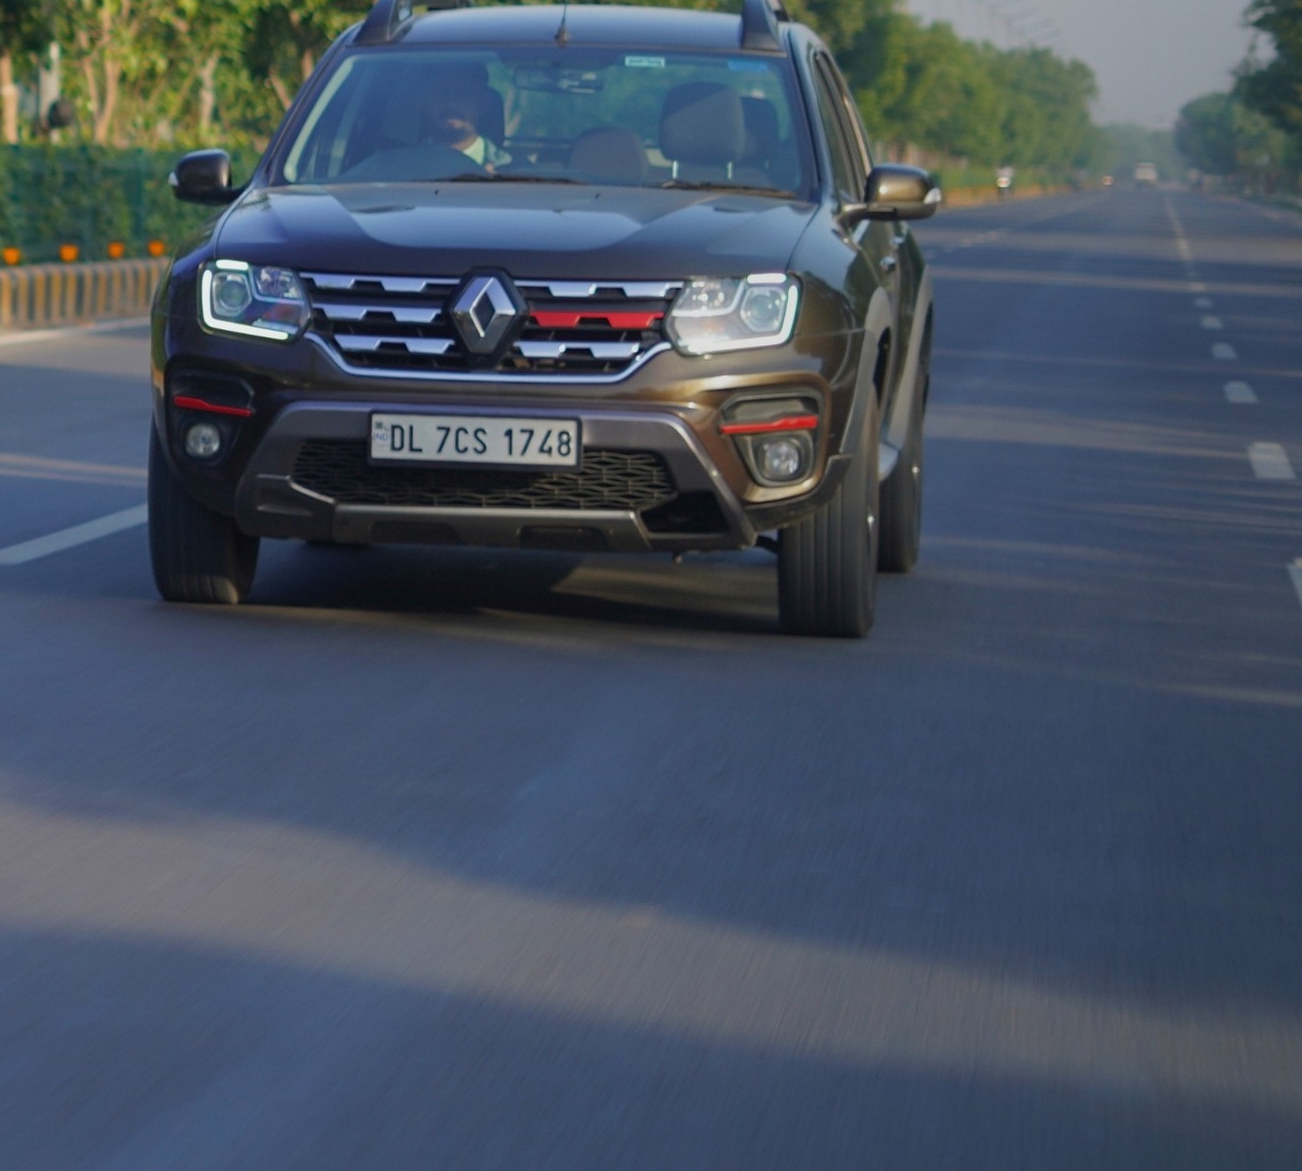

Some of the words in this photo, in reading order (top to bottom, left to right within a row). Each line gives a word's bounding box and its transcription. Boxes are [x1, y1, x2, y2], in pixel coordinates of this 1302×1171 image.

[390, 424, 423, 453] DL
[436, 426, 488, 455] 7CS
[504, 428, 572, 458] 1748
